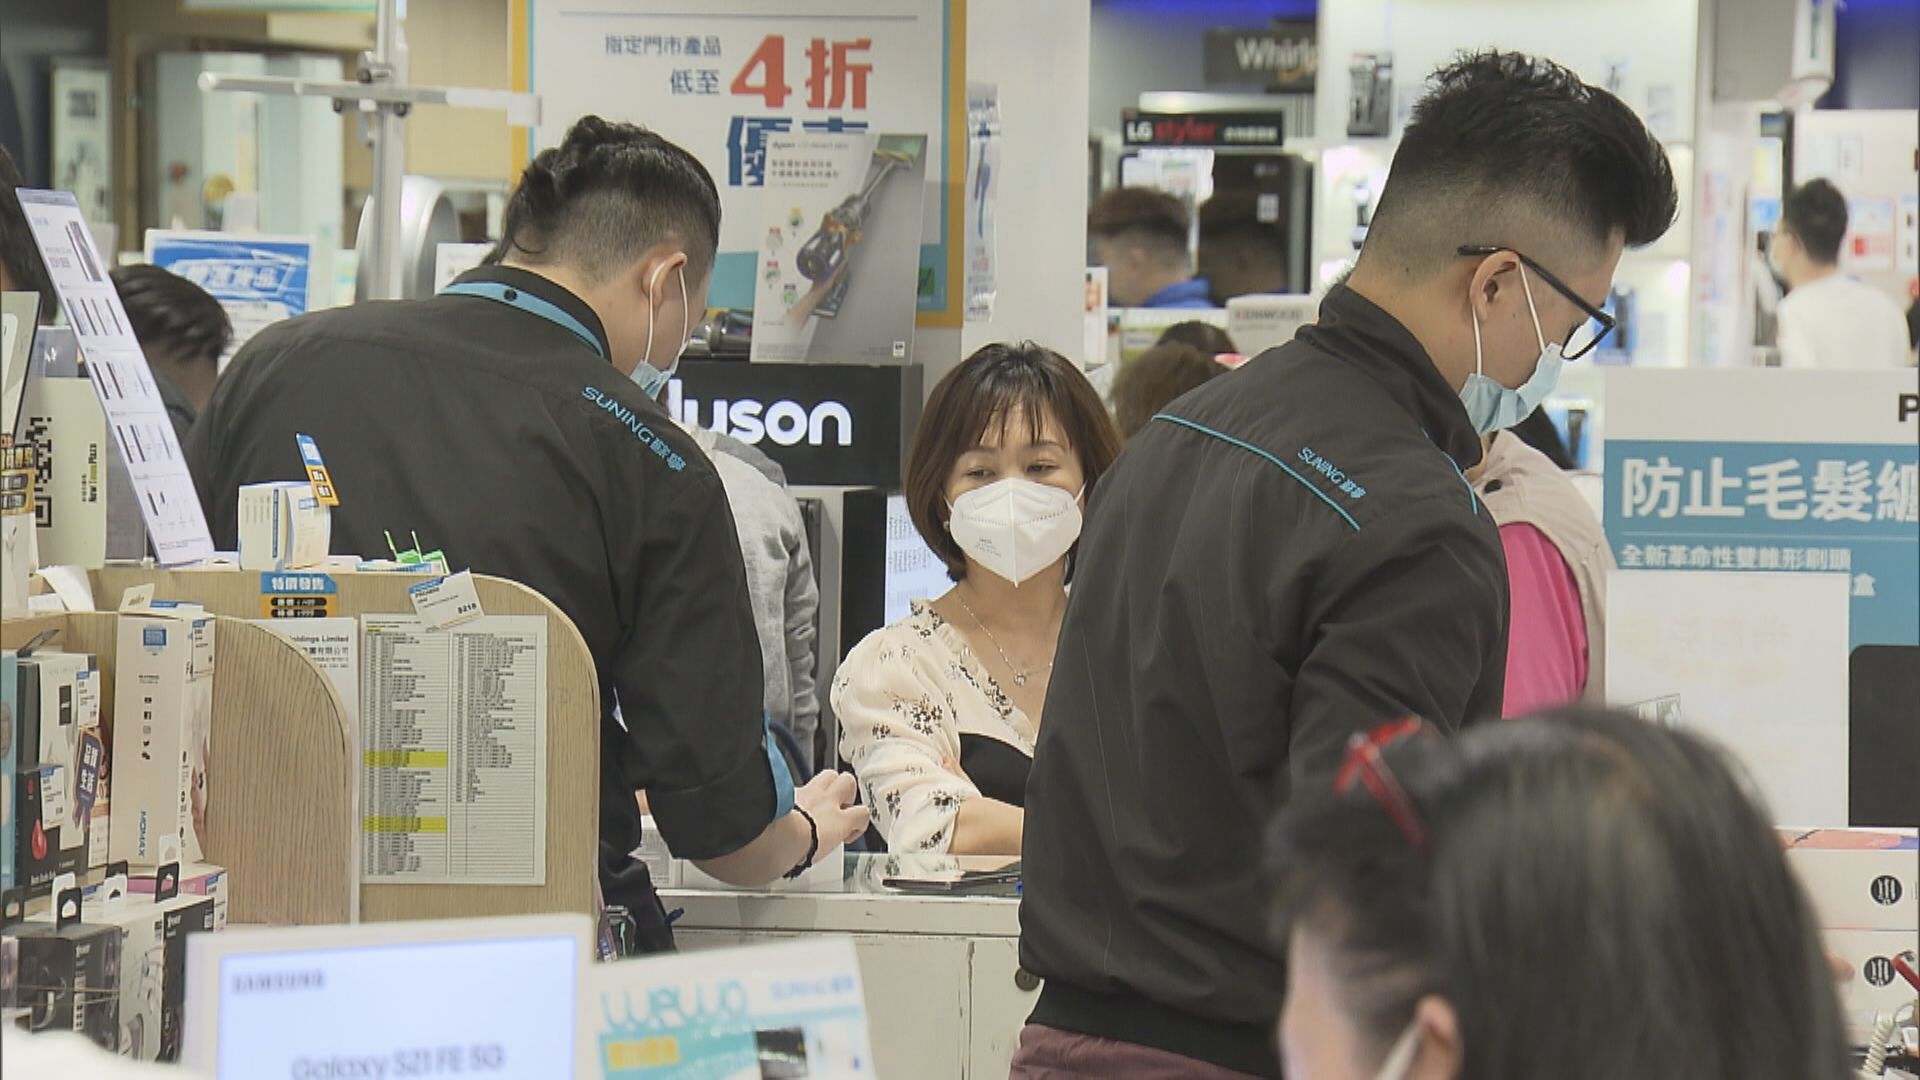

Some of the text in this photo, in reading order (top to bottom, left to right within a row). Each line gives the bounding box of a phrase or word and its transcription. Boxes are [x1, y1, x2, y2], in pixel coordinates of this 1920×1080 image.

[605, 35, 722, 57] 指定門市產品
[670, 35, 873, 110] 低至 4折
[1126, 120, 1153, 142] LG
[231, 969, 325, 995] SAMSUNG
[291, 1051, 388, 1080] Galaxy
